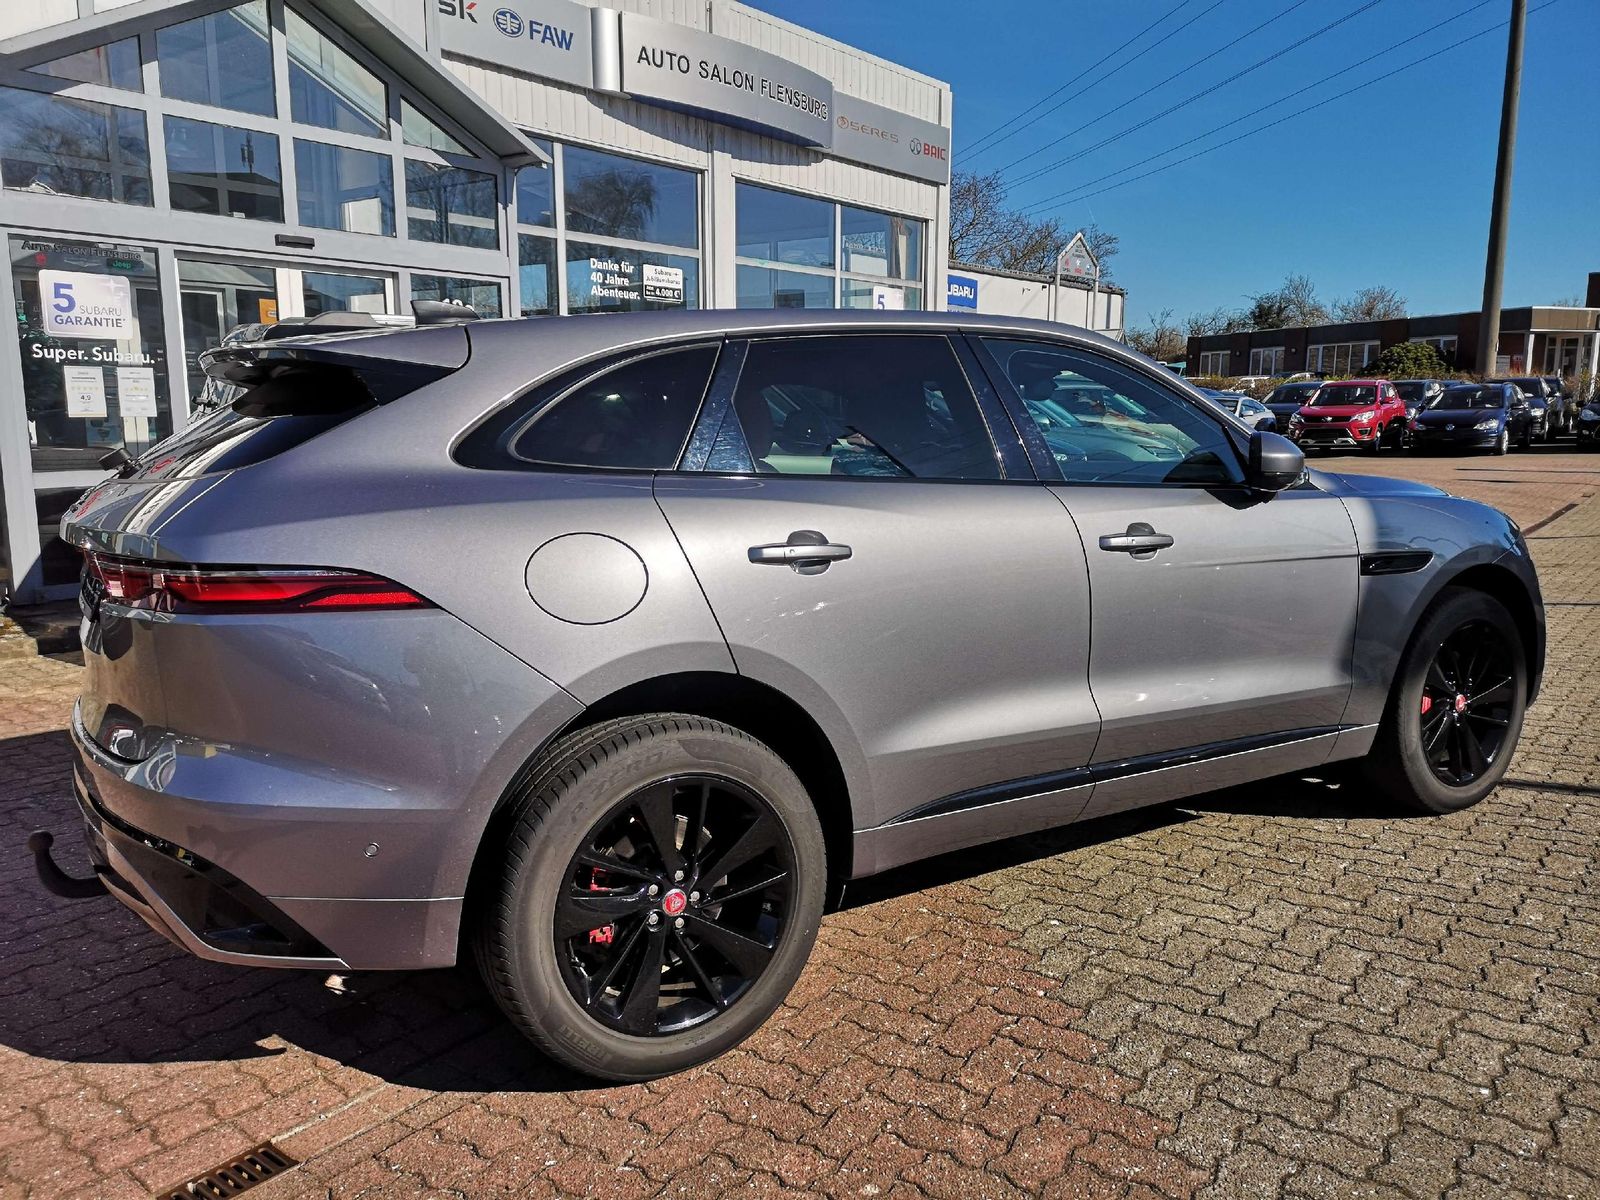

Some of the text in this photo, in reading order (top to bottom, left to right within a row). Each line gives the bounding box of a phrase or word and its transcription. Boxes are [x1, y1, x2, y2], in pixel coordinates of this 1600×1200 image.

[439, 0, 478, 24] SK
[529, 20, 573, 50] FAW
[637, 46, 828, 120] AUTO SALON FLENSBURG
[850, 120, 899, 143] SERES
[923, 143, 946, 160] BAIC
[112, 260, 132, 270] Jeep
[590, 258, 635, 273] Danke für
[590, 272, 629, 286] 40 Jahre
[53, 282, 121, 317] 5 SUBARU
[591, 286, 640, 300] Abenteuer.
[947, 284, 974, 299] UBARU
[877, 294, 885, 310] 5
[32, 343, 155, 364] Super. Subaru.
